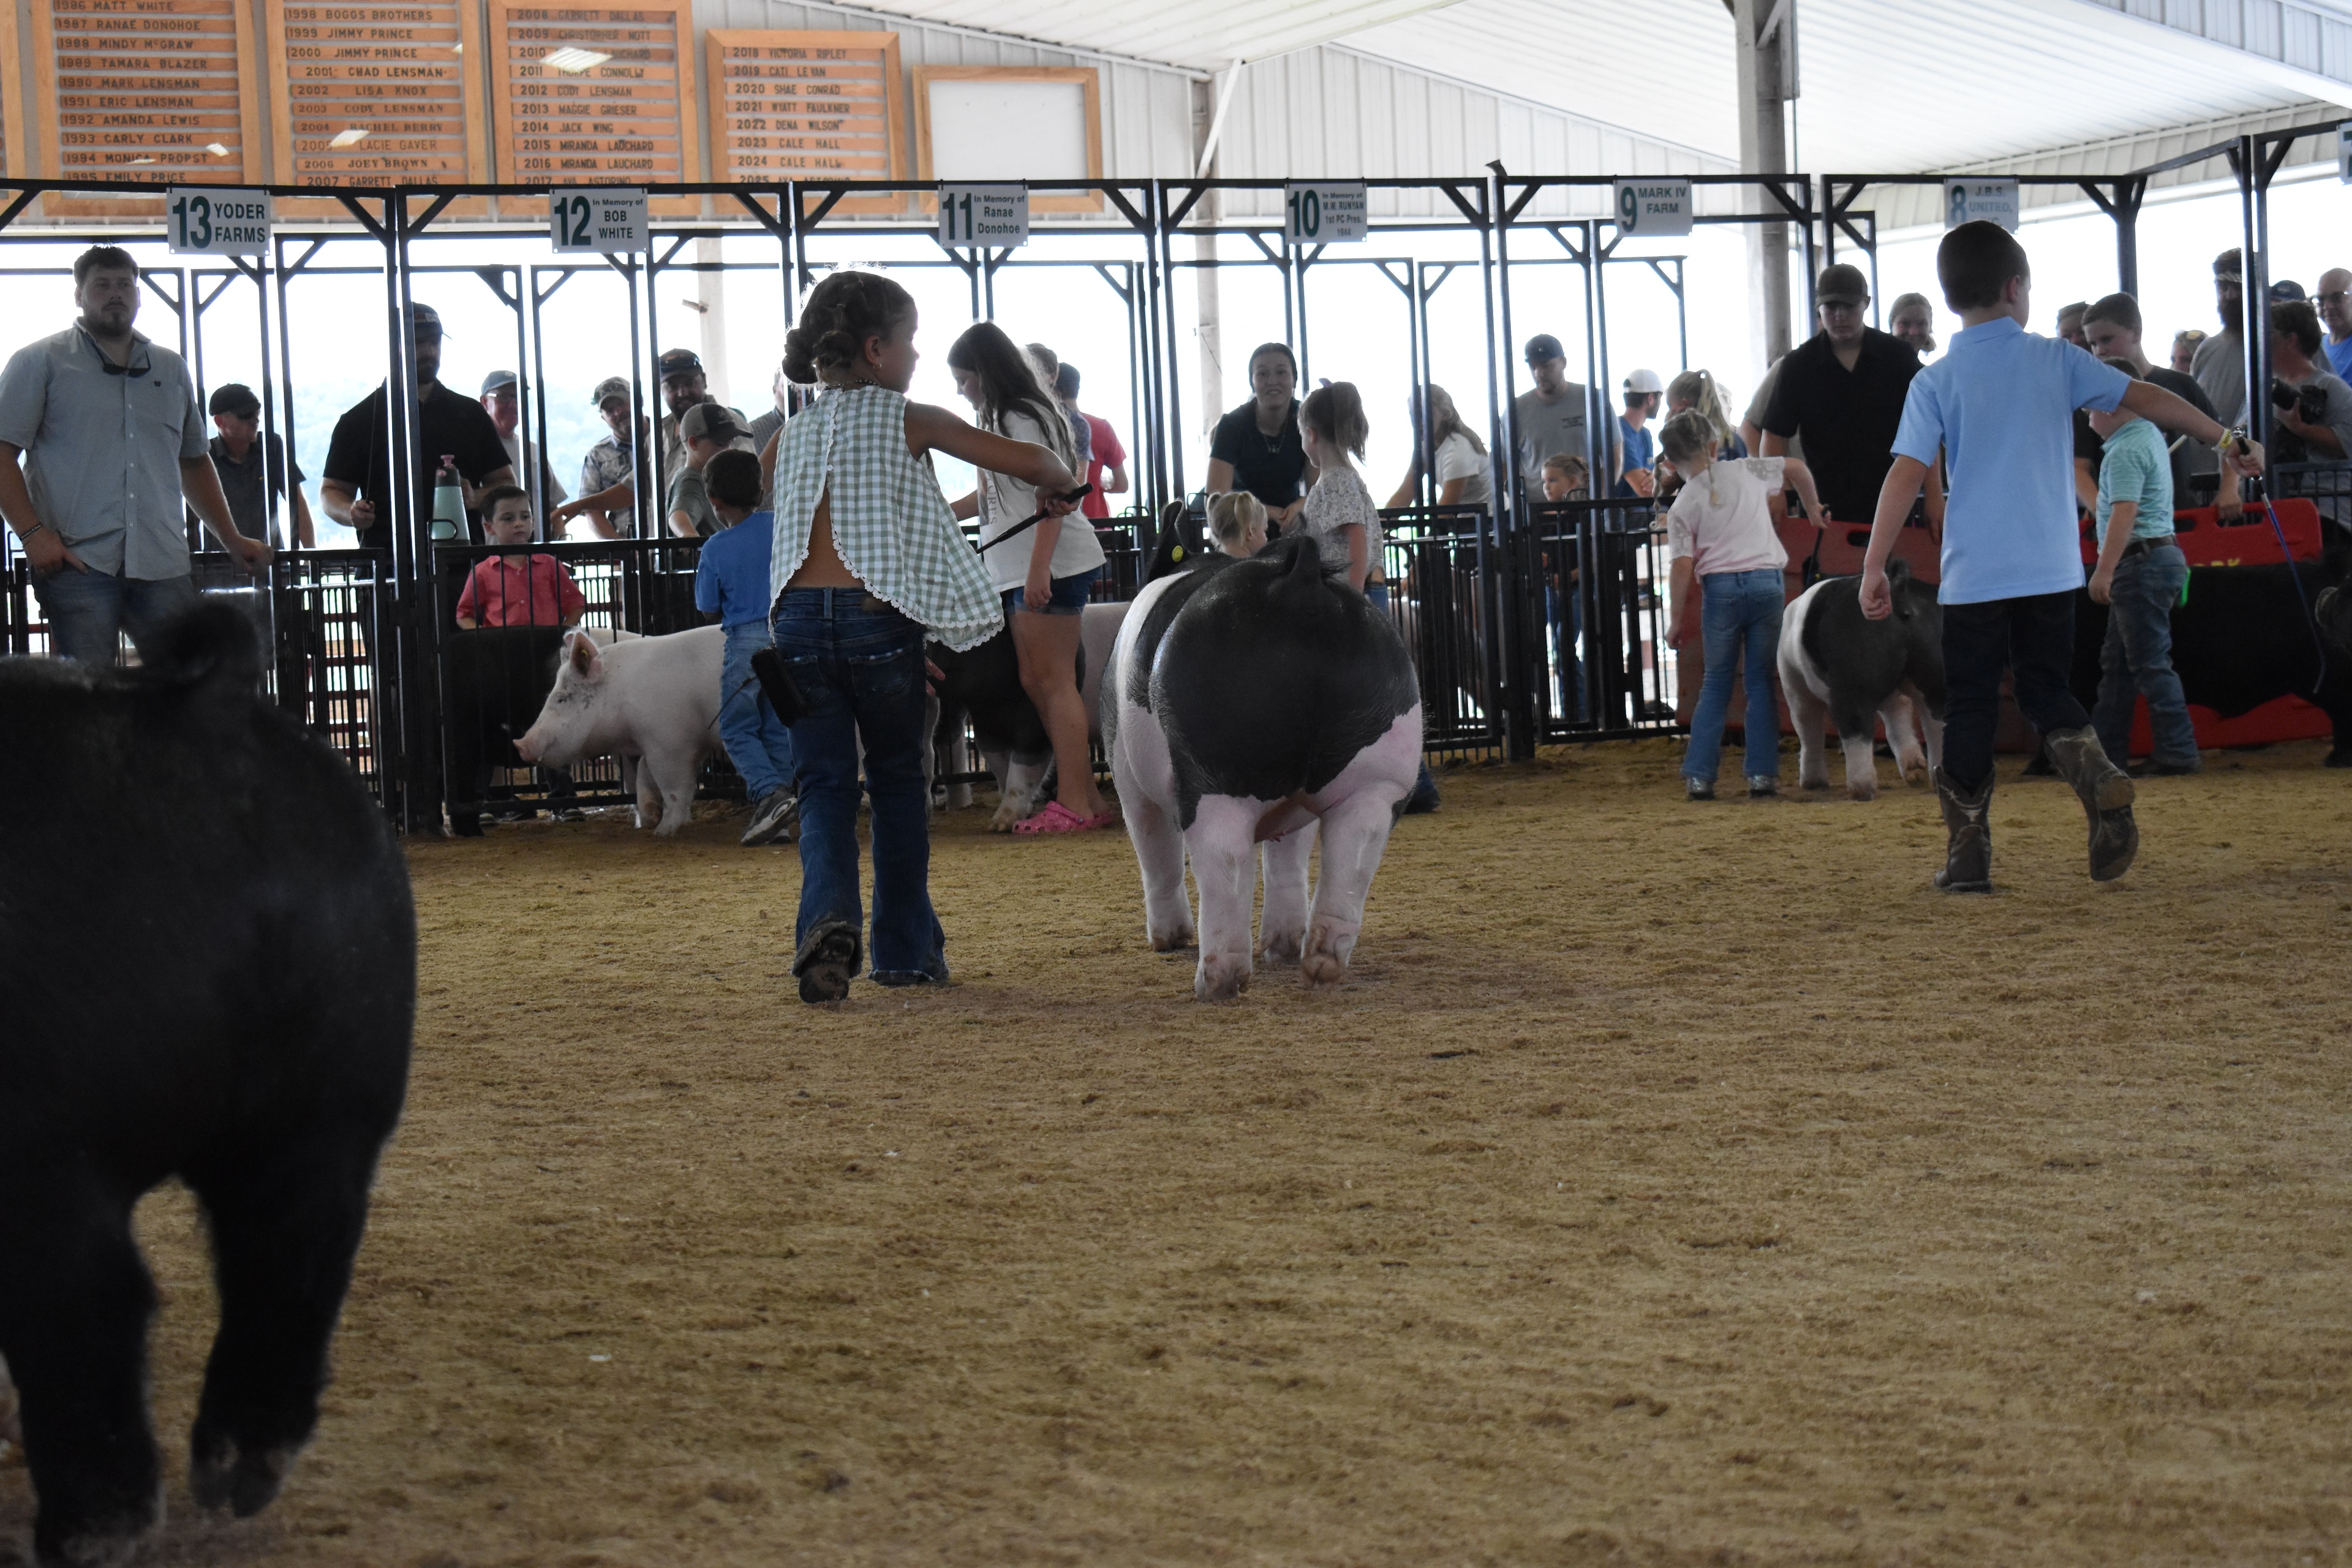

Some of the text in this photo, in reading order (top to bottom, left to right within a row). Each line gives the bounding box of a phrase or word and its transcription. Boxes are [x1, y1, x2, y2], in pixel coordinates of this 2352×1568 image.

[94, 1, 126, 10] MATT
[137, 2, 173, 11] WHITE
[288, 10, 432, 20] 1998 BOGGS BROTHERS
[518, 10, 548, 19] 2008
[58, 20, 200, 30] 1987 RANAE DONOHOE
[290, 29, 412, 39] 1999 JIMMY PRINCE
[519, 29, 548, 38] 2009
[559, 30, 618, 39] CHRISTOPHER
[60, 39, 89, 48] 1988
[99, 39, 137, 48] MINDY
[291, 48, 321, 57] 2000
[375, 49, 417, 58] PRINCE
[520, 48, 545, 57] 2010
[734, 48, 846, 59] 2018 VICTORIA RIPLEY
[61, 58, 207, 69] 1989 TAMARA BLAZER
[306, 67, 443, 77] 2001 CHAD LENSMAN
[521, 67, 543, 76] 2011
[601, 68, 644, 78] CONNOLLY
[735, 66, 760, 75] 2019
[62, 78, 200, 89] 1990 MARK LENSMAN
[396, 87, 426, 96] KNOX
[521, 86, 632, 96] 2012 CODY LENSMAN
[736, 84, 840, 95] 2020 SHAE CONRAD
[100, 97, 127, 107] ERIC
[136, 98, 193, 107] LENSMAN
[522, 104, 636, 115] 2013 MAGGIE GRIESER
[736, 102, 850, 113] 2021 WYATT FAULKNER
[104, 116, 153, 124] AMANDA
[164, 116, 200, 126] LEWIS
[737, 119, 839, 130] 2022 DENA WILSON
[522, 123, 613, 133] 2014 JACK WING
[66, 134, 192, 144] 1993 CARLY CLARK
[738, 137, 840, 149] 2023 CALE HALL
[360, 141, 391, 150] LACIE
[400, 140, 436, 150] GAVER
[524, 140, 654, 151] 2015 MIRANDA LAUCHARD
[67, 153, 96, 162] 1994
[160, 154, 207, 164] PROPST
[305, 159, 428, 168] 2006 JOEY BROWN
[525, 159, 653, 168] 2016 MIRANDA LAUCHARD
[739, 156, 842, 168] 2024 CALE HALL
[67, 172, 186, 183] 1995 EMILY PRICE
[307, 177, 339, 186] 2007
[350, 177, 391, 186] GARRETT
[1638, 188, 1686, 198] MARK IV
[1620, 186, 1637, 232] 9
[1647, 203, 1678, 213] FARM
[1951, 185, 1966, 225] 8
[214, 203, 265, 219] YODER
[605, 211, 627, 221] BOB
[984, 206, 1013, 217] Ranae
[1289, 190, 1319, 237] 10
[554, 196, 591, 246] 12
[943, 193, 972, 240] 11
[173, 196, 211, 249] 13
[599, 228, 633, 238] WHITE
[978, 223, 1020, 233] Donohoe
[216, 227, 265, 243] FARMS
